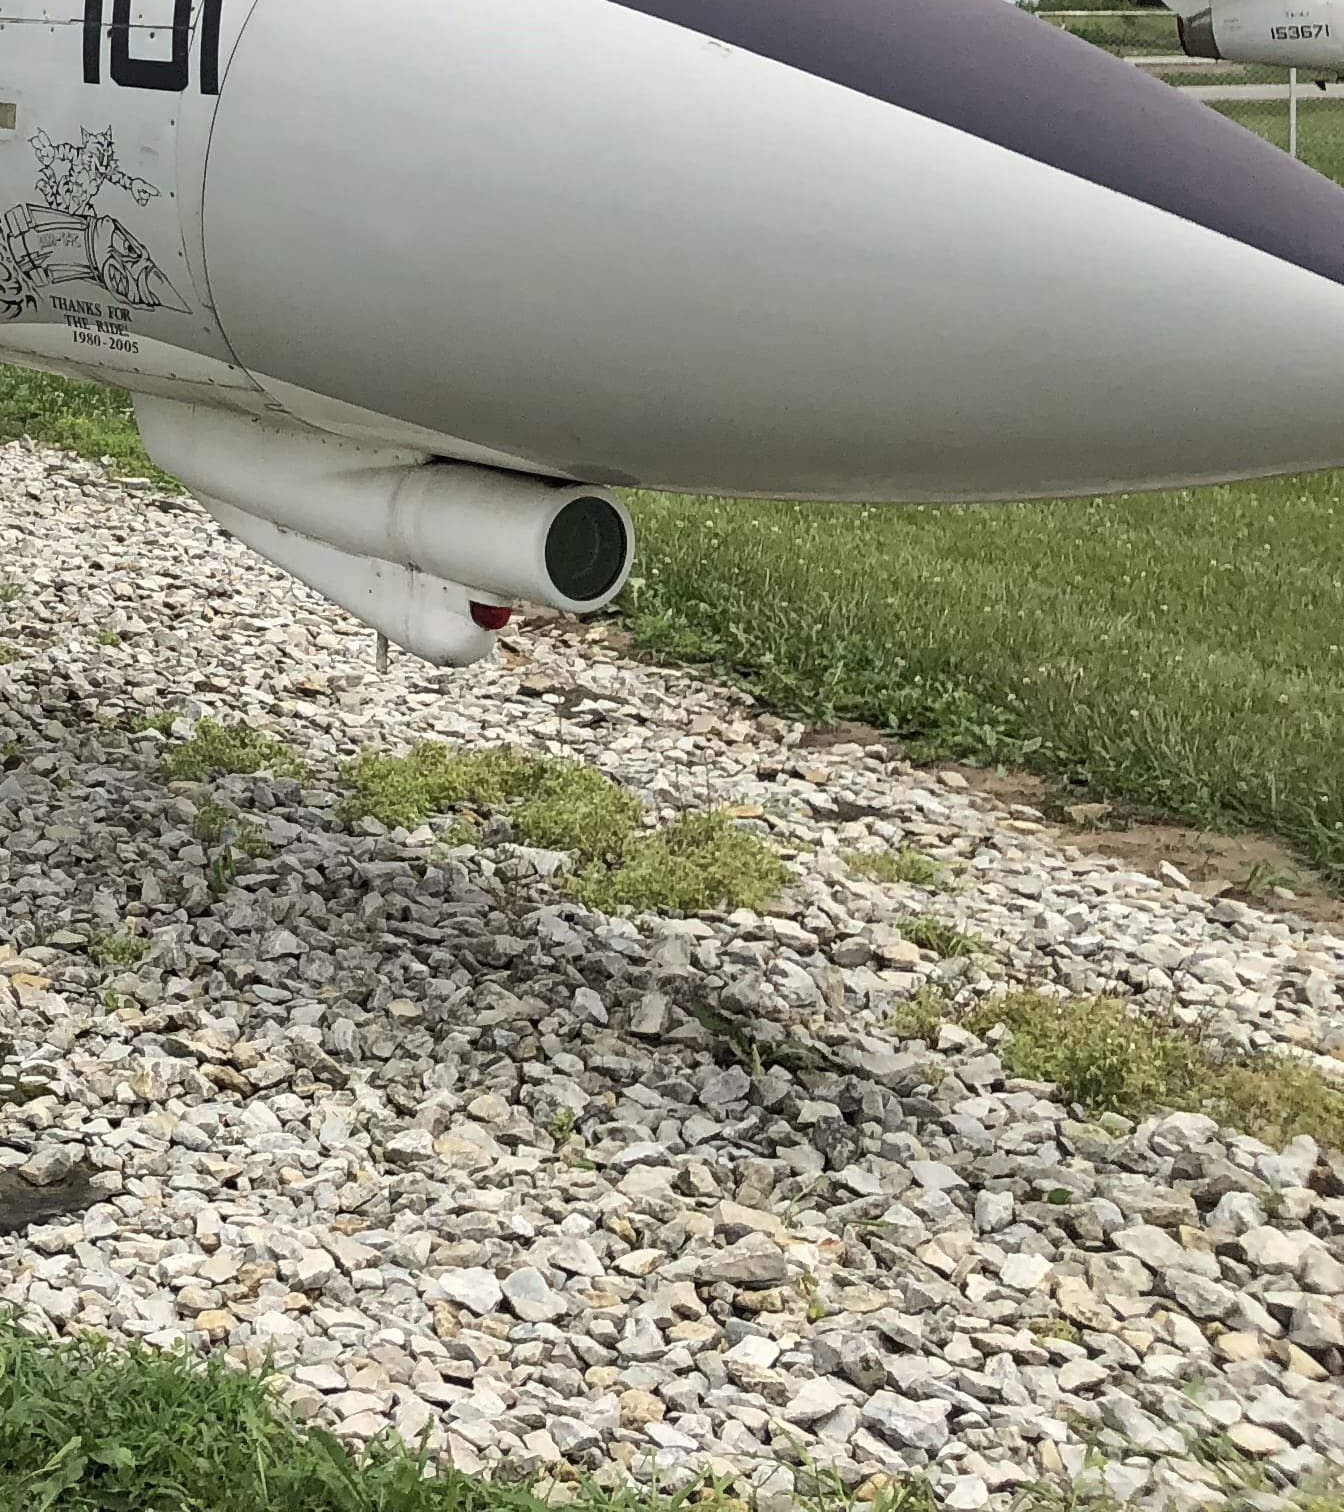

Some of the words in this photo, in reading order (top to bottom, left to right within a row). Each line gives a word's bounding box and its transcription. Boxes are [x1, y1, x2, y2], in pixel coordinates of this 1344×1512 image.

[1271, 24, 1330, 40] 153671
[50, 295, 102, 317] THANKS
[108, 306, 132, 322] FOR
[64, 314, 90, 330] THE
[73, 330, 140, 354] 1980-2005
